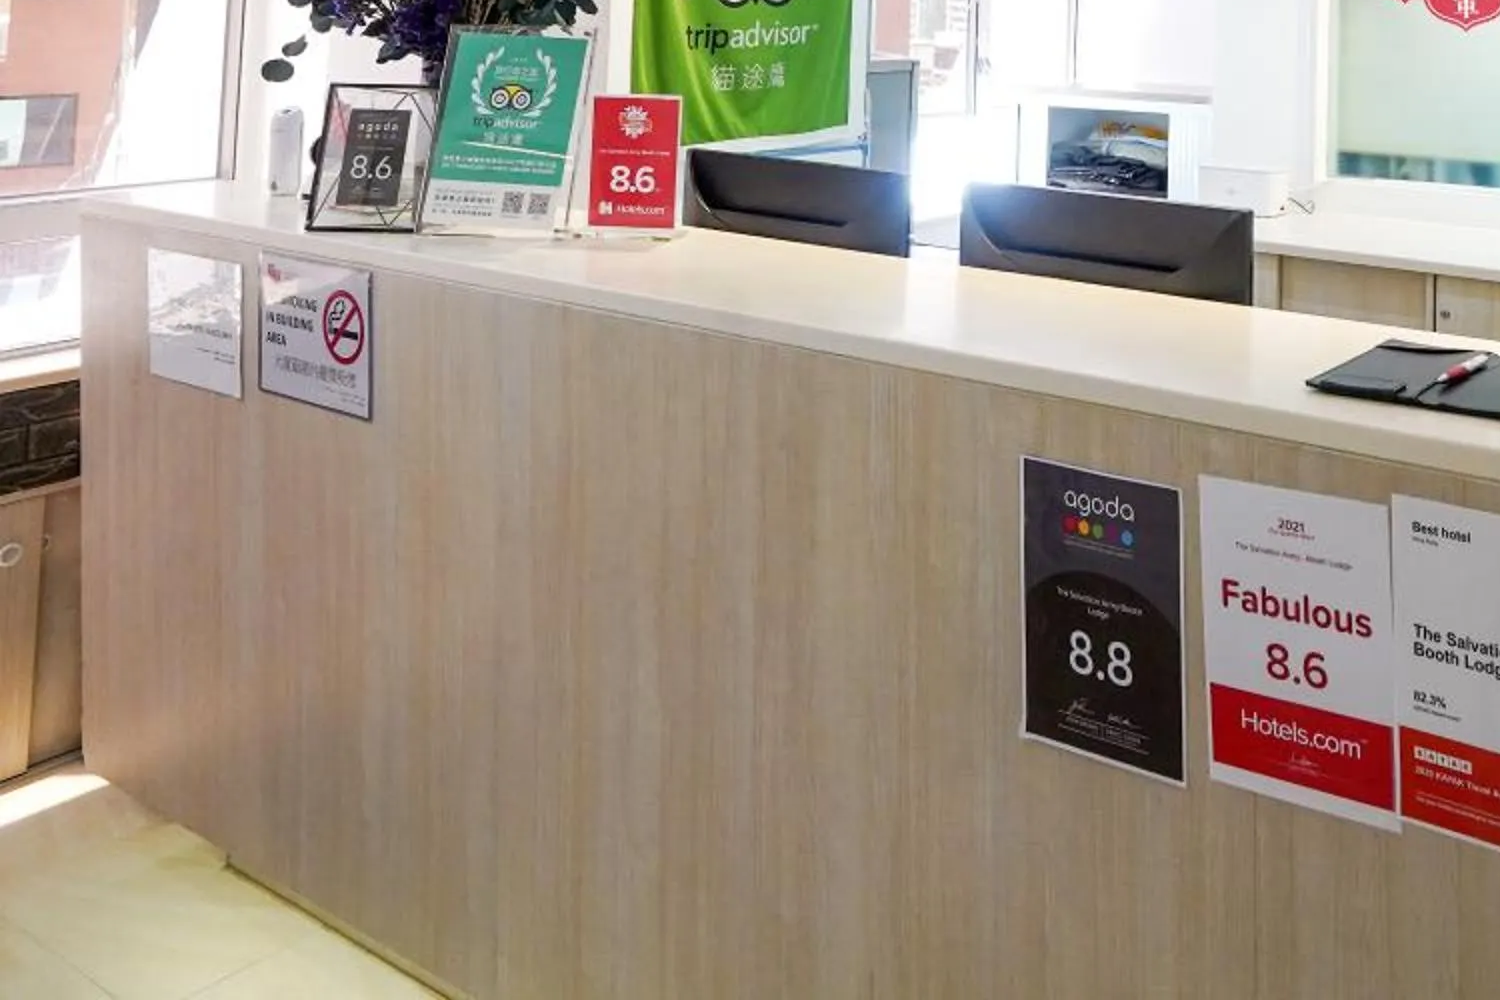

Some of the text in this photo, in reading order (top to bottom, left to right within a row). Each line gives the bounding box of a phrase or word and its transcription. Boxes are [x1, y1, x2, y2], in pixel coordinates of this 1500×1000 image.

[686, 19, 812, 55] tripadvisor
[350, 155, 392, 179] 8.6
[609, 165, 656, 193] 8.6
[265, 331, 287, 347] AREA
[1063, 489, 1136, 524] agoda
[1278, 517, 1306, 533] 2021
[1411, 521, 1472, 545] Best hotel
[1221, 578, 1373, 639] Fabulous
[1413, 623, 1442, 644] The
[1069, 629, 1134, 688] 8.8
[1265, 643, 1329, 690] 8.6
[1413, 641, 1460, 669] Booth
[1241, 708, 1361, 761] Hotels.com
